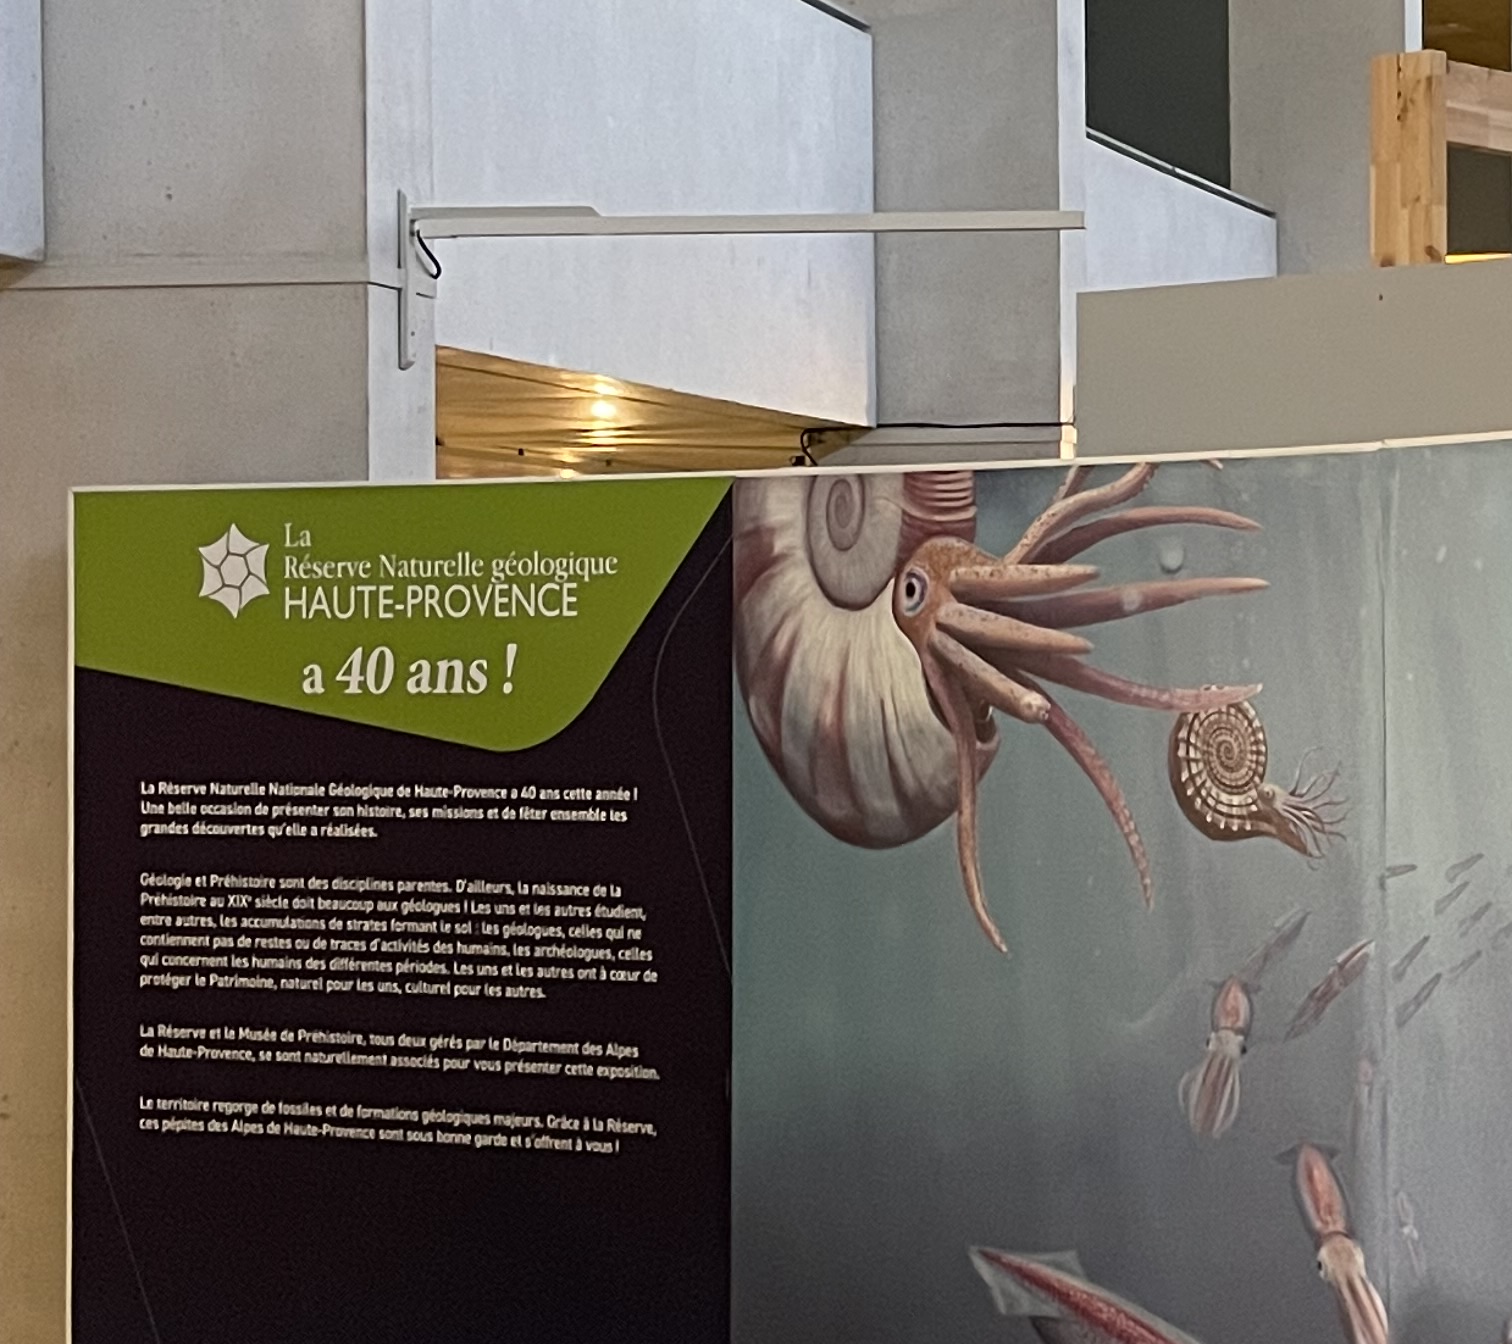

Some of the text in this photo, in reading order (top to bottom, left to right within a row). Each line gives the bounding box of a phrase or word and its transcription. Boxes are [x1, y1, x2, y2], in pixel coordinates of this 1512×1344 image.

[286, 524, 310, 546] La
[285, 551, 617, 586] Réserve Naturelle géologique
[285, 584, 577, 618] HAUTE-PROVENCE
[303, 644, 517, 694] a 40 ans !
[140, 782, 155, 794] La
[158, 782, 206, 794] Réserve
[209, 782, 266, 796] Naturelle
[268, 782, 325, 796] Nationale
[328, 782, 394, 800] Géologique
[396, 786, 411, 798] de
[414, 784, 507, 800] Haute-Provence
[520, 786, 536, 800] 40
[538, 788, 560, 800] ans
[562, 788, 592, 800] cette
[594, 786, 630, 800] année
[140, 800, 164, 814] Une
[167, 802, 197, 816] belle
[199, 802, 252, 816] occasion
[254, 802, 269, 816] de
[271, 802, 330, 818] présenter
[332, 806, 354, 816] son
[408, 808, 428, 818] ses
[431, 804, 484, 820] missions
[486, 808, 499, 820] et
[501, 806, 516, 820] de
[518, 806, 547, 820] fêter
[549, 808, 606, 822] ensemble
[609, 810, 628, 822] les
[140, 820, 188, 838] grandes
[191, 820, 265, 836] découvertes
[139, 872, 192, 890] Géologie
[194, 876, 206, 888] et
[209, 874, 276, 888] Préhistoire
[278, 878, 304, 888] sont
[307, 876, 328, 890] des
[517, 880, 529, 894] la
[531, 882, 590, 896] naissance
[592, 884, 607, 898] de
[609, 884, 621, 898] la
[140, 892, 206, 908] Préhistoire
[209, 896, 224, 908] au
[254, 894, 288, 910] siècle
[292, 898, 314, 910] doit
[317, 896, 374, 914] beaucoup
[376, 900, 398, 912] aux
[400, 898, 460, 916] géologues
[470, 900, 491, 914] Les
[493, 904, 516, 916] uns
[518, 904, 530, 916] et
[532, 904, 550, 916] les
[554, 904, 592, 918] autres
[139, 914, 172, 926] entre
[219, 914, 238, 928] les
[328, 916, 343, 930] de
[346, 920, 387, 932] strates
[390, 918, 437, 932] formant
[439, 920, 451, 934] le
[454, 920, 472, 934] sol
[481, 922, 499, 936] les
[568, 924, 602, 938] celles
[605, 926, 624, 942] qui
[626, 928, 642, 940] ne
[212, 936, 234, 950] pas
[236, 934, 252, 948] de
[254, 936, 292, 950] restes
[294, 938, 310, 950] ou
[312, 936, 327, 950] de
[432, 940, 454, 954] des
[512, 944, 530, 956] les
[617, 948, 653, 962] celles
[139, 952, 158, 968] qui
[230, 954, 249, 968] les
[251, 956, 302, 970] humains
[304, 956, 326, 970] des
[453, 962, 474, 976] Les
[476, 964, 498, 976] uns
[500, 964, 513, 976] et
[515, 964, 534, 978] les
[536, 966, 574, 978] autres
[576, 968, 596, 980] ont
[642, 970, 658, 982] de
[139, 972, 192, 990] protéger
[194, 974, 206, 986] le
[280, 976, 323, 990] naturel
[326, 980, 354, 992] pour
[356, 978, 374, 992] les
[404, 980, 450, 994] culturel
[453, 984, 481, 998] pour
[484, 984, 502, 998] les
[139, 1024, 639, 1060] La Réserve et le Musée de tous deux gérés par le des Alpes
[139, 1044, 154, 1058] de
[258, 1050, 272, 1062] se
[275, 1050, 301, 1062] sont
[389, 1054, 440, 1068] associés
[442, 1058, 470, 1072] pour
[473, 1060, 501, 1072] vous
[504, 1060, 562, 1074] présenter
[564, 1064, 594, 1076] cette
[139, 1096, 154, 1110] Le
[156, 1098, 210, 1112] territoire
[212, 1102, 258, 1116] regorge
[260, 1100, 276, 1114] de
[324, 1106, 337, 1116] et
[338, 1104, 354, 1118] de
[421, 1108, 491, 1126] géologiques
[546, 1114, 580, 1130] Grâce
[592, 1118, 604, 1132] la
[138, 1118, 613, 1154] ces des Alpes de Haute-Provence sont sous garde et vous
